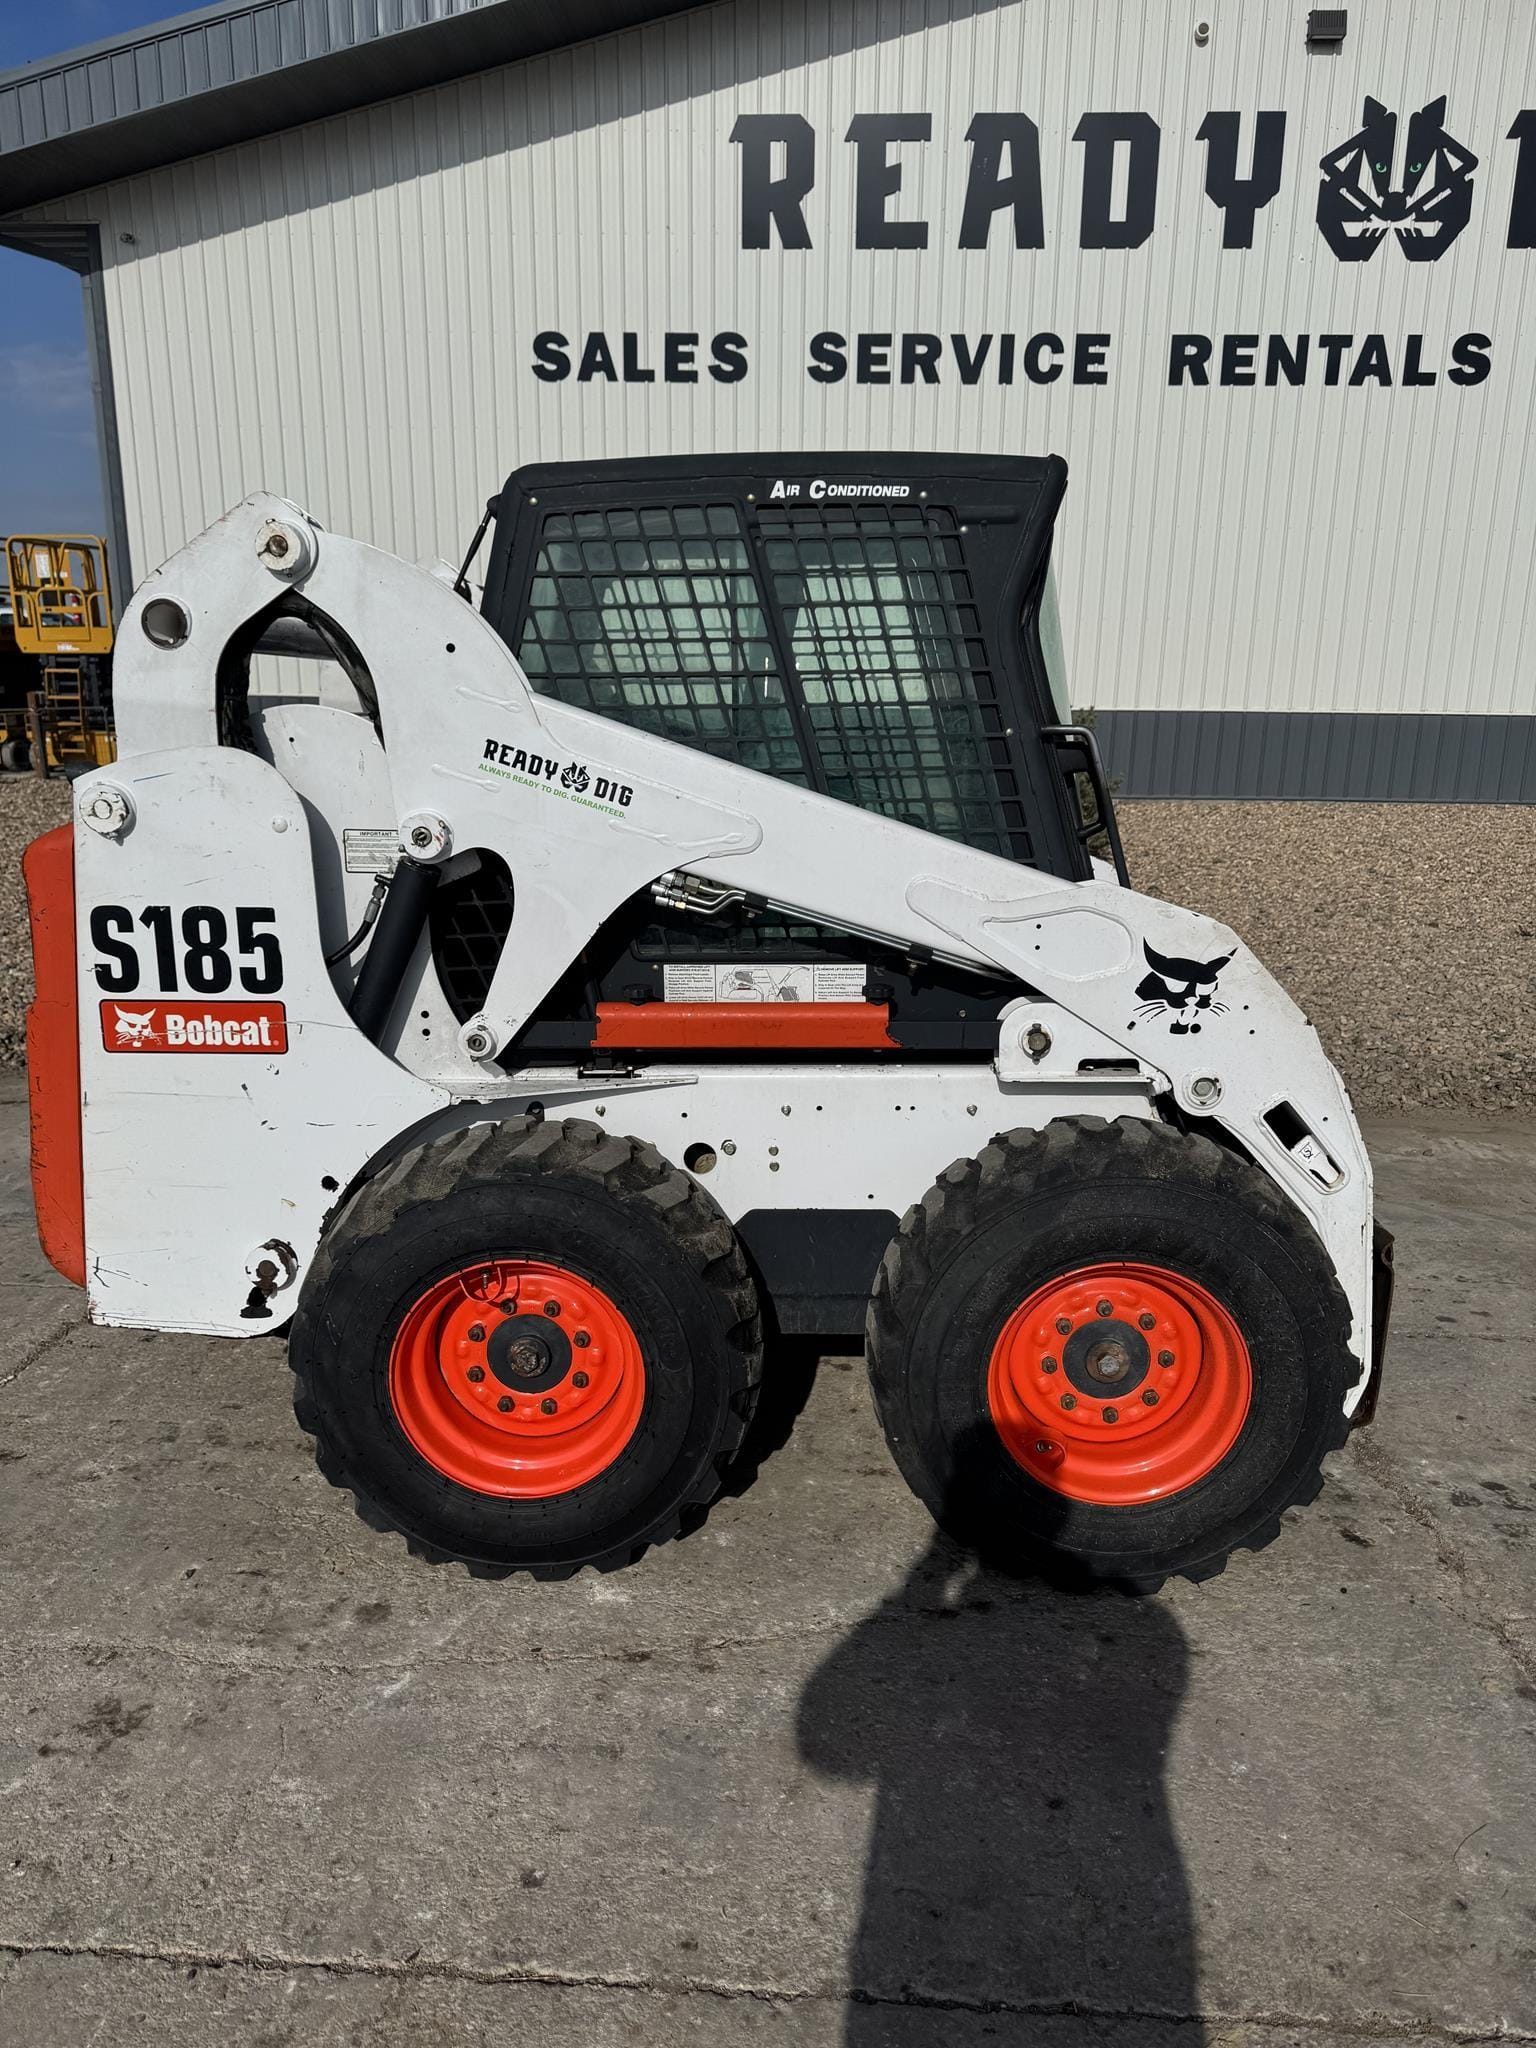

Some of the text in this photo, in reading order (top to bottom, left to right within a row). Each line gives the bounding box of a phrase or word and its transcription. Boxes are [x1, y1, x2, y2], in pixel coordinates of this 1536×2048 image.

[729, 111, 1287, 249] READY
[532, 332, 1491, 386] SALES SERVICE RENTALS
[478, 763, 627, 819] ALWAYS READY TO DIG. GUARANTEED.
[483, 738, 634, 807] READY DIG
[90, 905, 284, 994] S185
[165, 1014, 272, 1046] Bobcat
